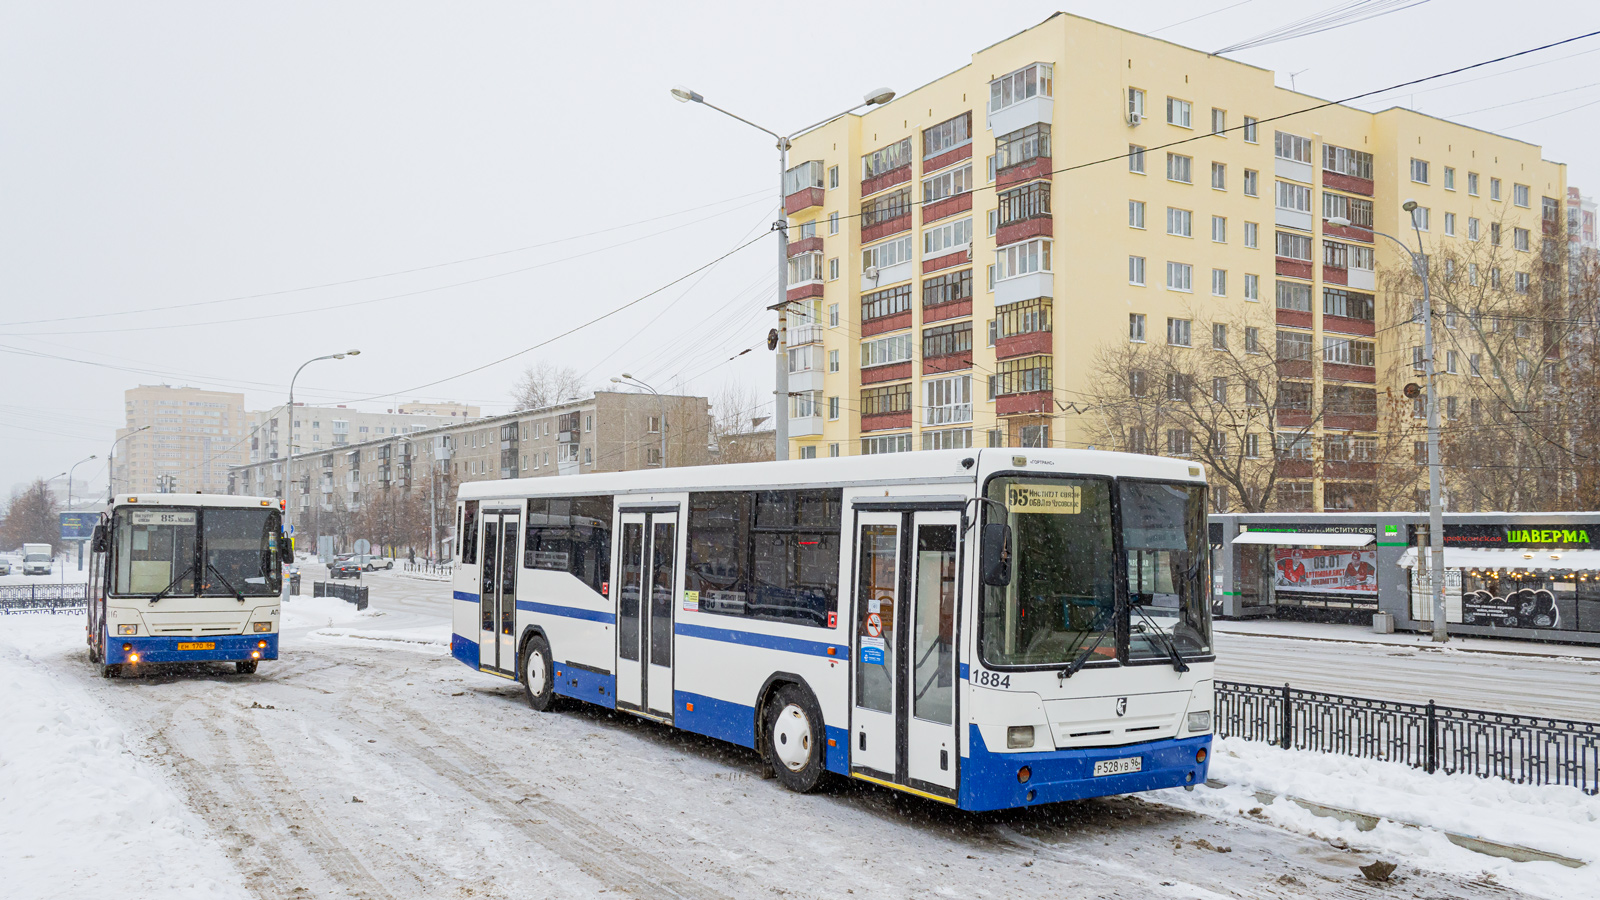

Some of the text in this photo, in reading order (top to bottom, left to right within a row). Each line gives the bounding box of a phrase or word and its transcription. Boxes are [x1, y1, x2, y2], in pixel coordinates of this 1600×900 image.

[1507, 529, 1590, 544] ШАВЕРМА
[1313, 554, 1340, 569] 09.01
[972, 669, 1010, 689] 1884
